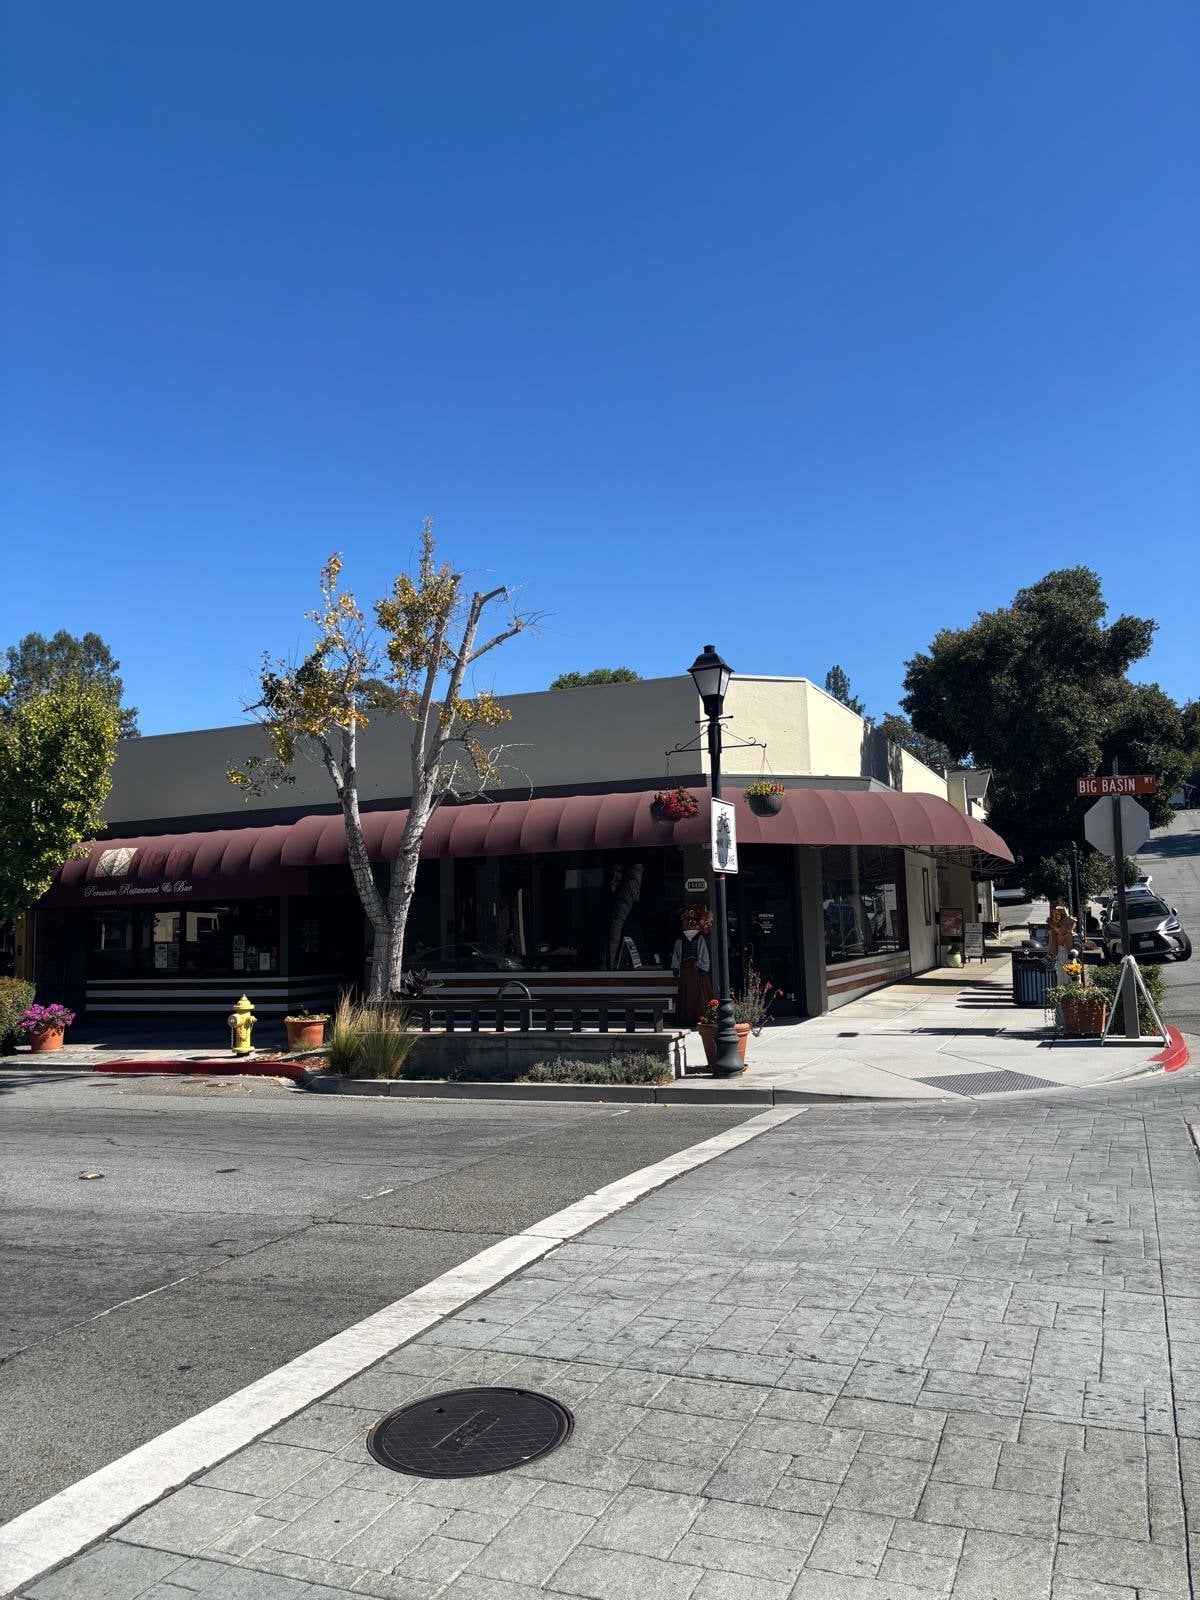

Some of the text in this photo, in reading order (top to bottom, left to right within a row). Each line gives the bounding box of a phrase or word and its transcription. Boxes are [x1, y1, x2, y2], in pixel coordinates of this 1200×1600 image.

[1079, 780, 1096, 793] BIG
[1101, 778, 1135, 792] BASIN
[84, 880, 192, 897] Peruvian Restaurant & Bar
